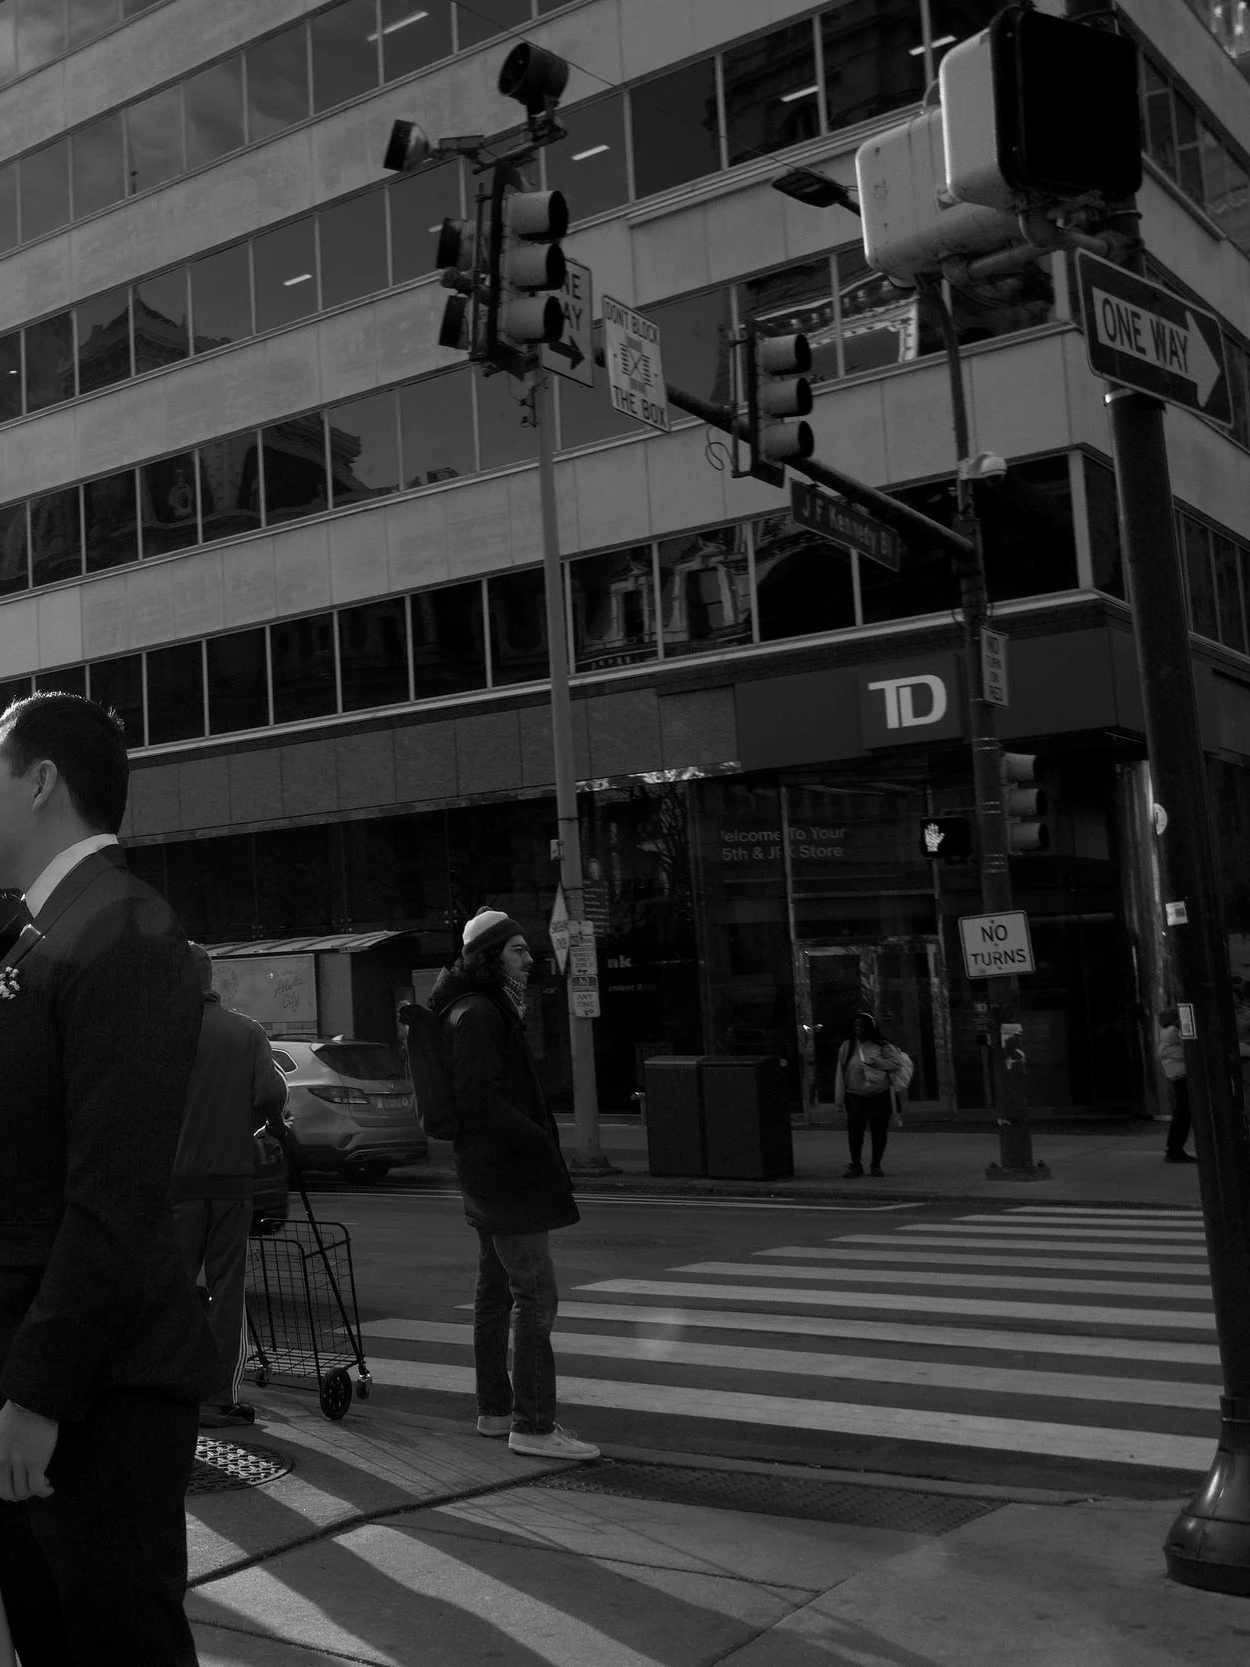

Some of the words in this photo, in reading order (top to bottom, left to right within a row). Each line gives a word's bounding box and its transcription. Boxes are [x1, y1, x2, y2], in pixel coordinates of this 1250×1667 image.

[563, 302, 583, 332] AY
[631, 315, 660, 346] BLOCK
[1102, 298, 1147, 356] ONE
[1150, 318, 1189, 374] WAY
[612, 385, 639, 415] THE
[641, 398, 668, 429] BOX
[802, 493, 810, 518] J
[815, 498, 823, 522] F
[829, 503, 878, 555] Kennedy
[985, 635, 1000, 655] NO
[989, 671, 1000, 684] ON
[867, 673, 948, 729] TD
[989, 685, 1003, 701] RED
[720, 828, 782, 843] elcome
[788, 826, 807, 841] To
[809, 825, 847, 841] Your
[752, 845, 764, 860] &
[798, 844, 845, 859] Store
[980, 924, 1008, 943] NO
[970, 948, 1027, 967] TURNS
[577, 993, 593, 1001] ANY
